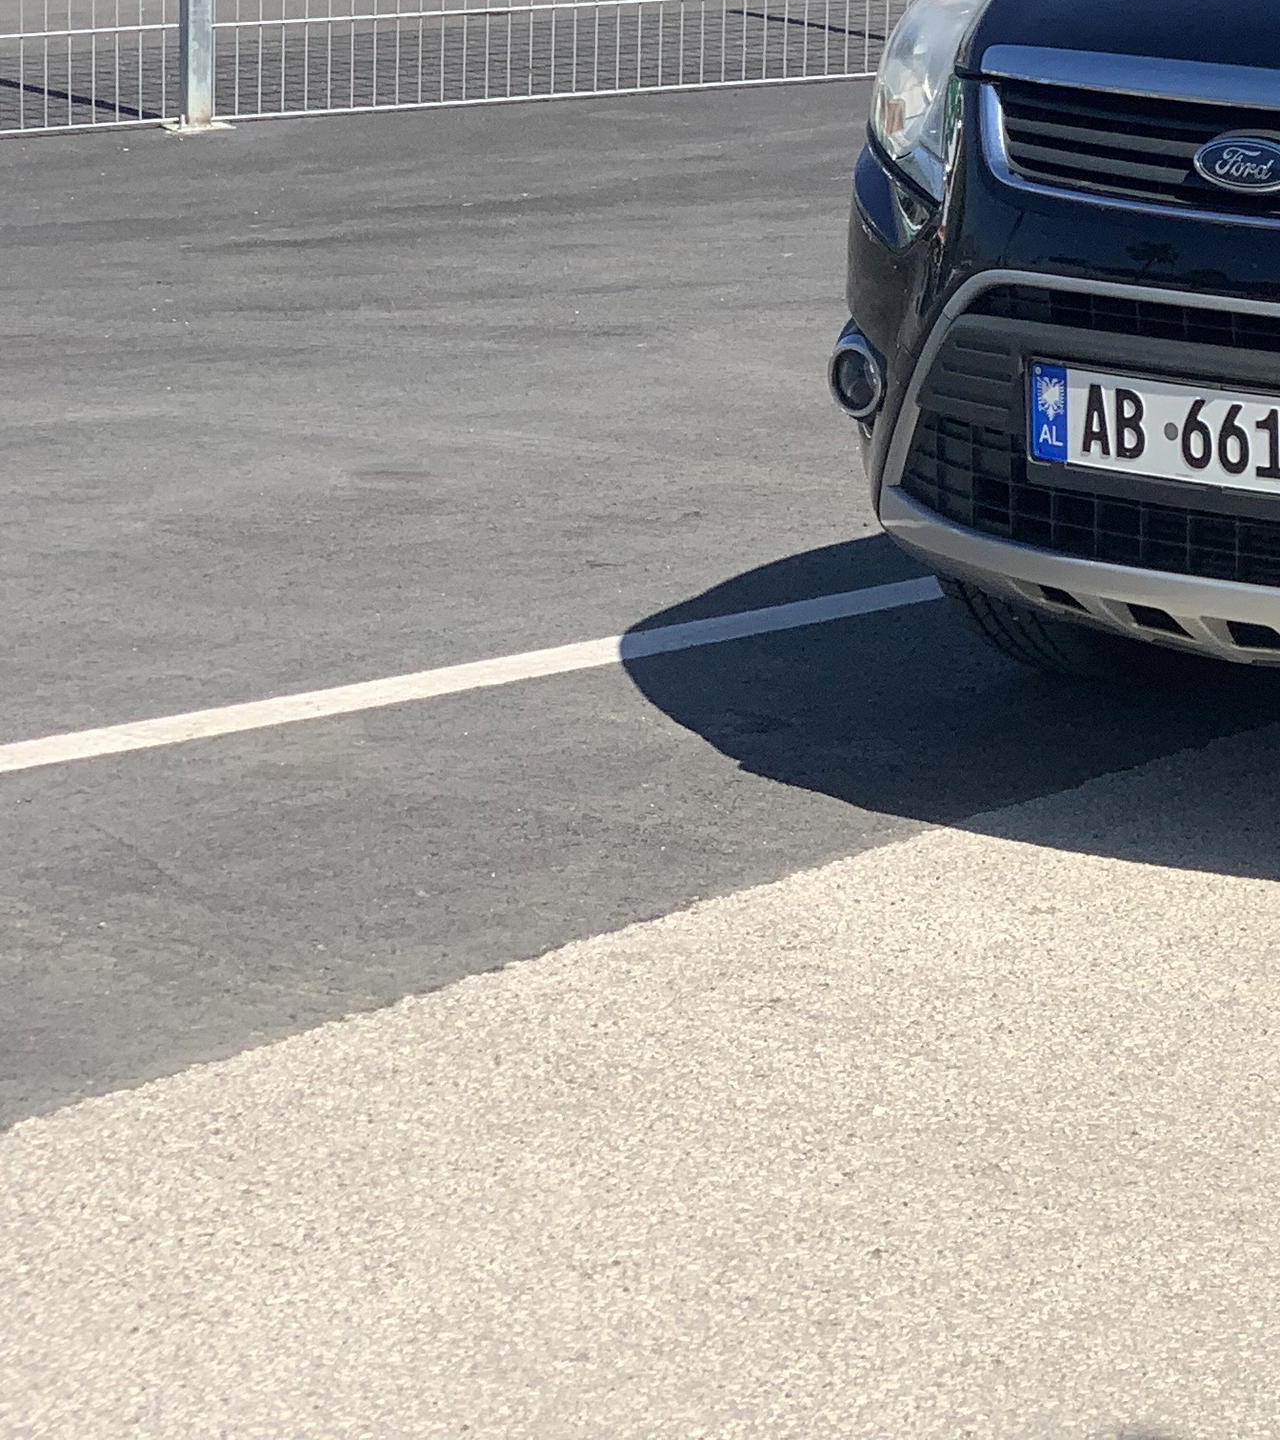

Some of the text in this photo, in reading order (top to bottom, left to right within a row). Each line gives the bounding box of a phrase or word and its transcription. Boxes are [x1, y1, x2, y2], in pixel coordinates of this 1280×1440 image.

[1215, 147, 1274, 179] Ford
[1038, 424, 1063, 447] AL
[1081, 384, 1145, 459] AB
